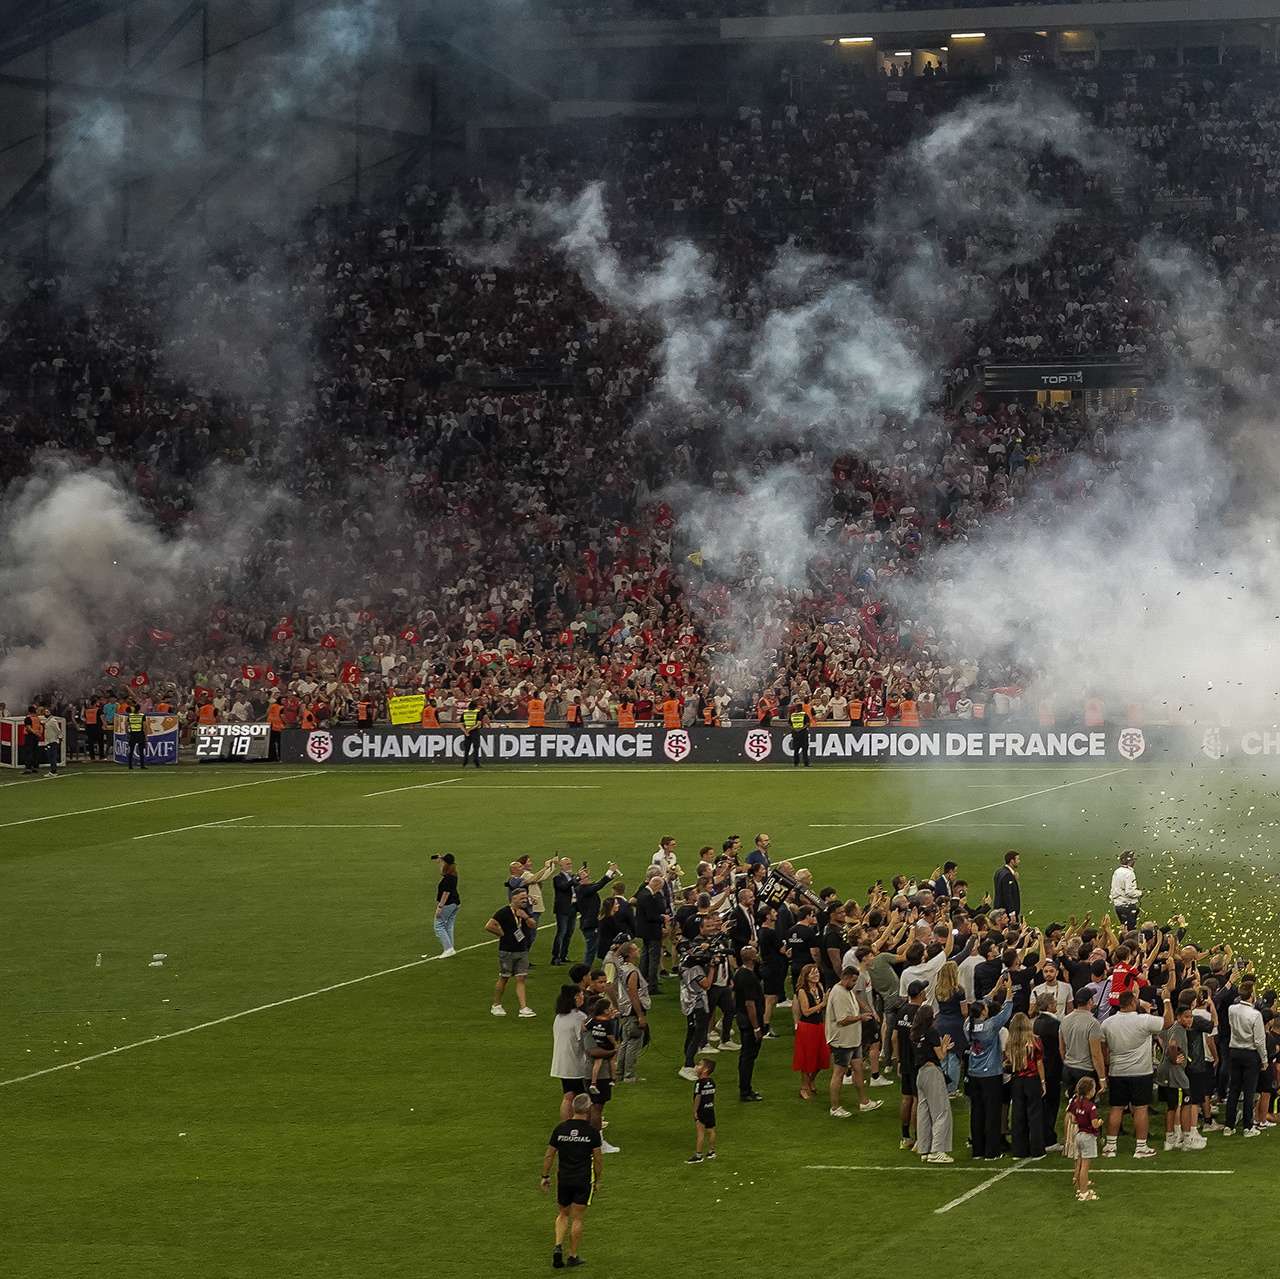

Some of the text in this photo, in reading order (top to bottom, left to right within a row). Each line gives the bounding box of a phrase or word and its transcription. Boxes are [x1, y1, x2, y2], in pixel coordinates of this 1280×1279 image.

[220, 725, 268, 736] TISSOT
[196, 737, 222, 755] 23
[500, 734, 535, 758] DE
[541, 733, 653, 758] FRANCE
[946, 732, 983, 756] DE
[989, 732, 1105, 756] FRANCE
[760, 878, 775, 895] TOP
